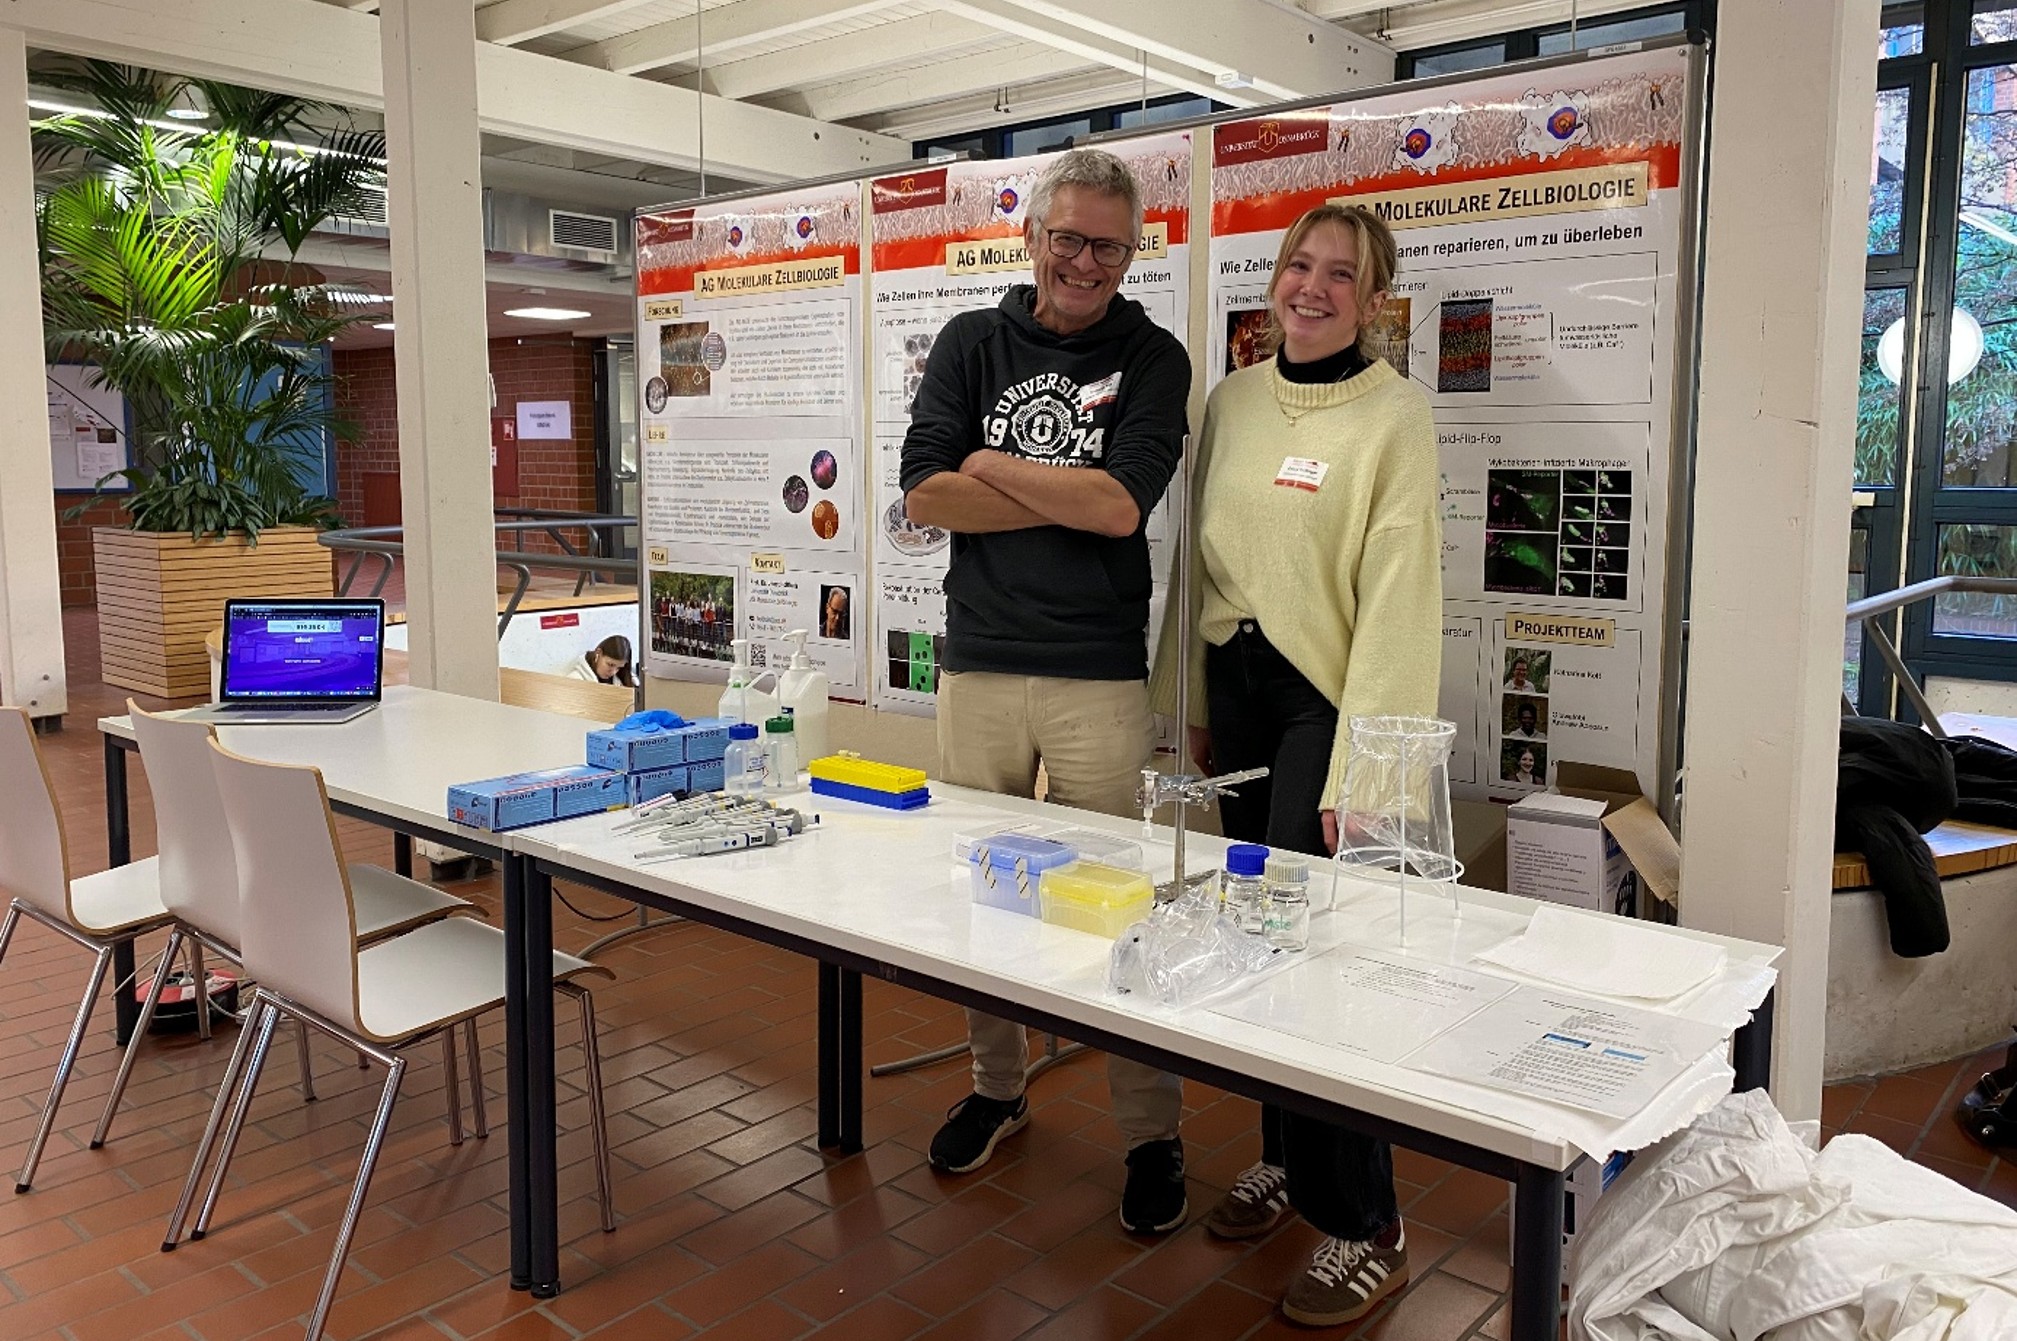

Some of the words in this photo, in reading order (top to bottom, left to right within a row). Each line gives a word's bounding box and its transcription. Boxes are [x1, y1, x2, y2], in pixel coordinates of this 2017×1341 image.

[1433, 238, 1510, 257] reparieren,
[1515, 235, 1537, 247] um
[1541, 233, 1558, 245] zu
[1563, 225, 1642, 244] überleben
[957, 249, 975, 267] AG
[980, 247, 1031, 265] MOLEKU
[1220, 259, 1241, 274] Wie
[1244, 258, 1277, 273] Zelle
[701, 278, 715, 293] AG
[1127, 275, 1140, 284] zu
[1143, 270, 1171, 283] töten
[1514, 620, 1605, 640] PROJEKTTEAM
